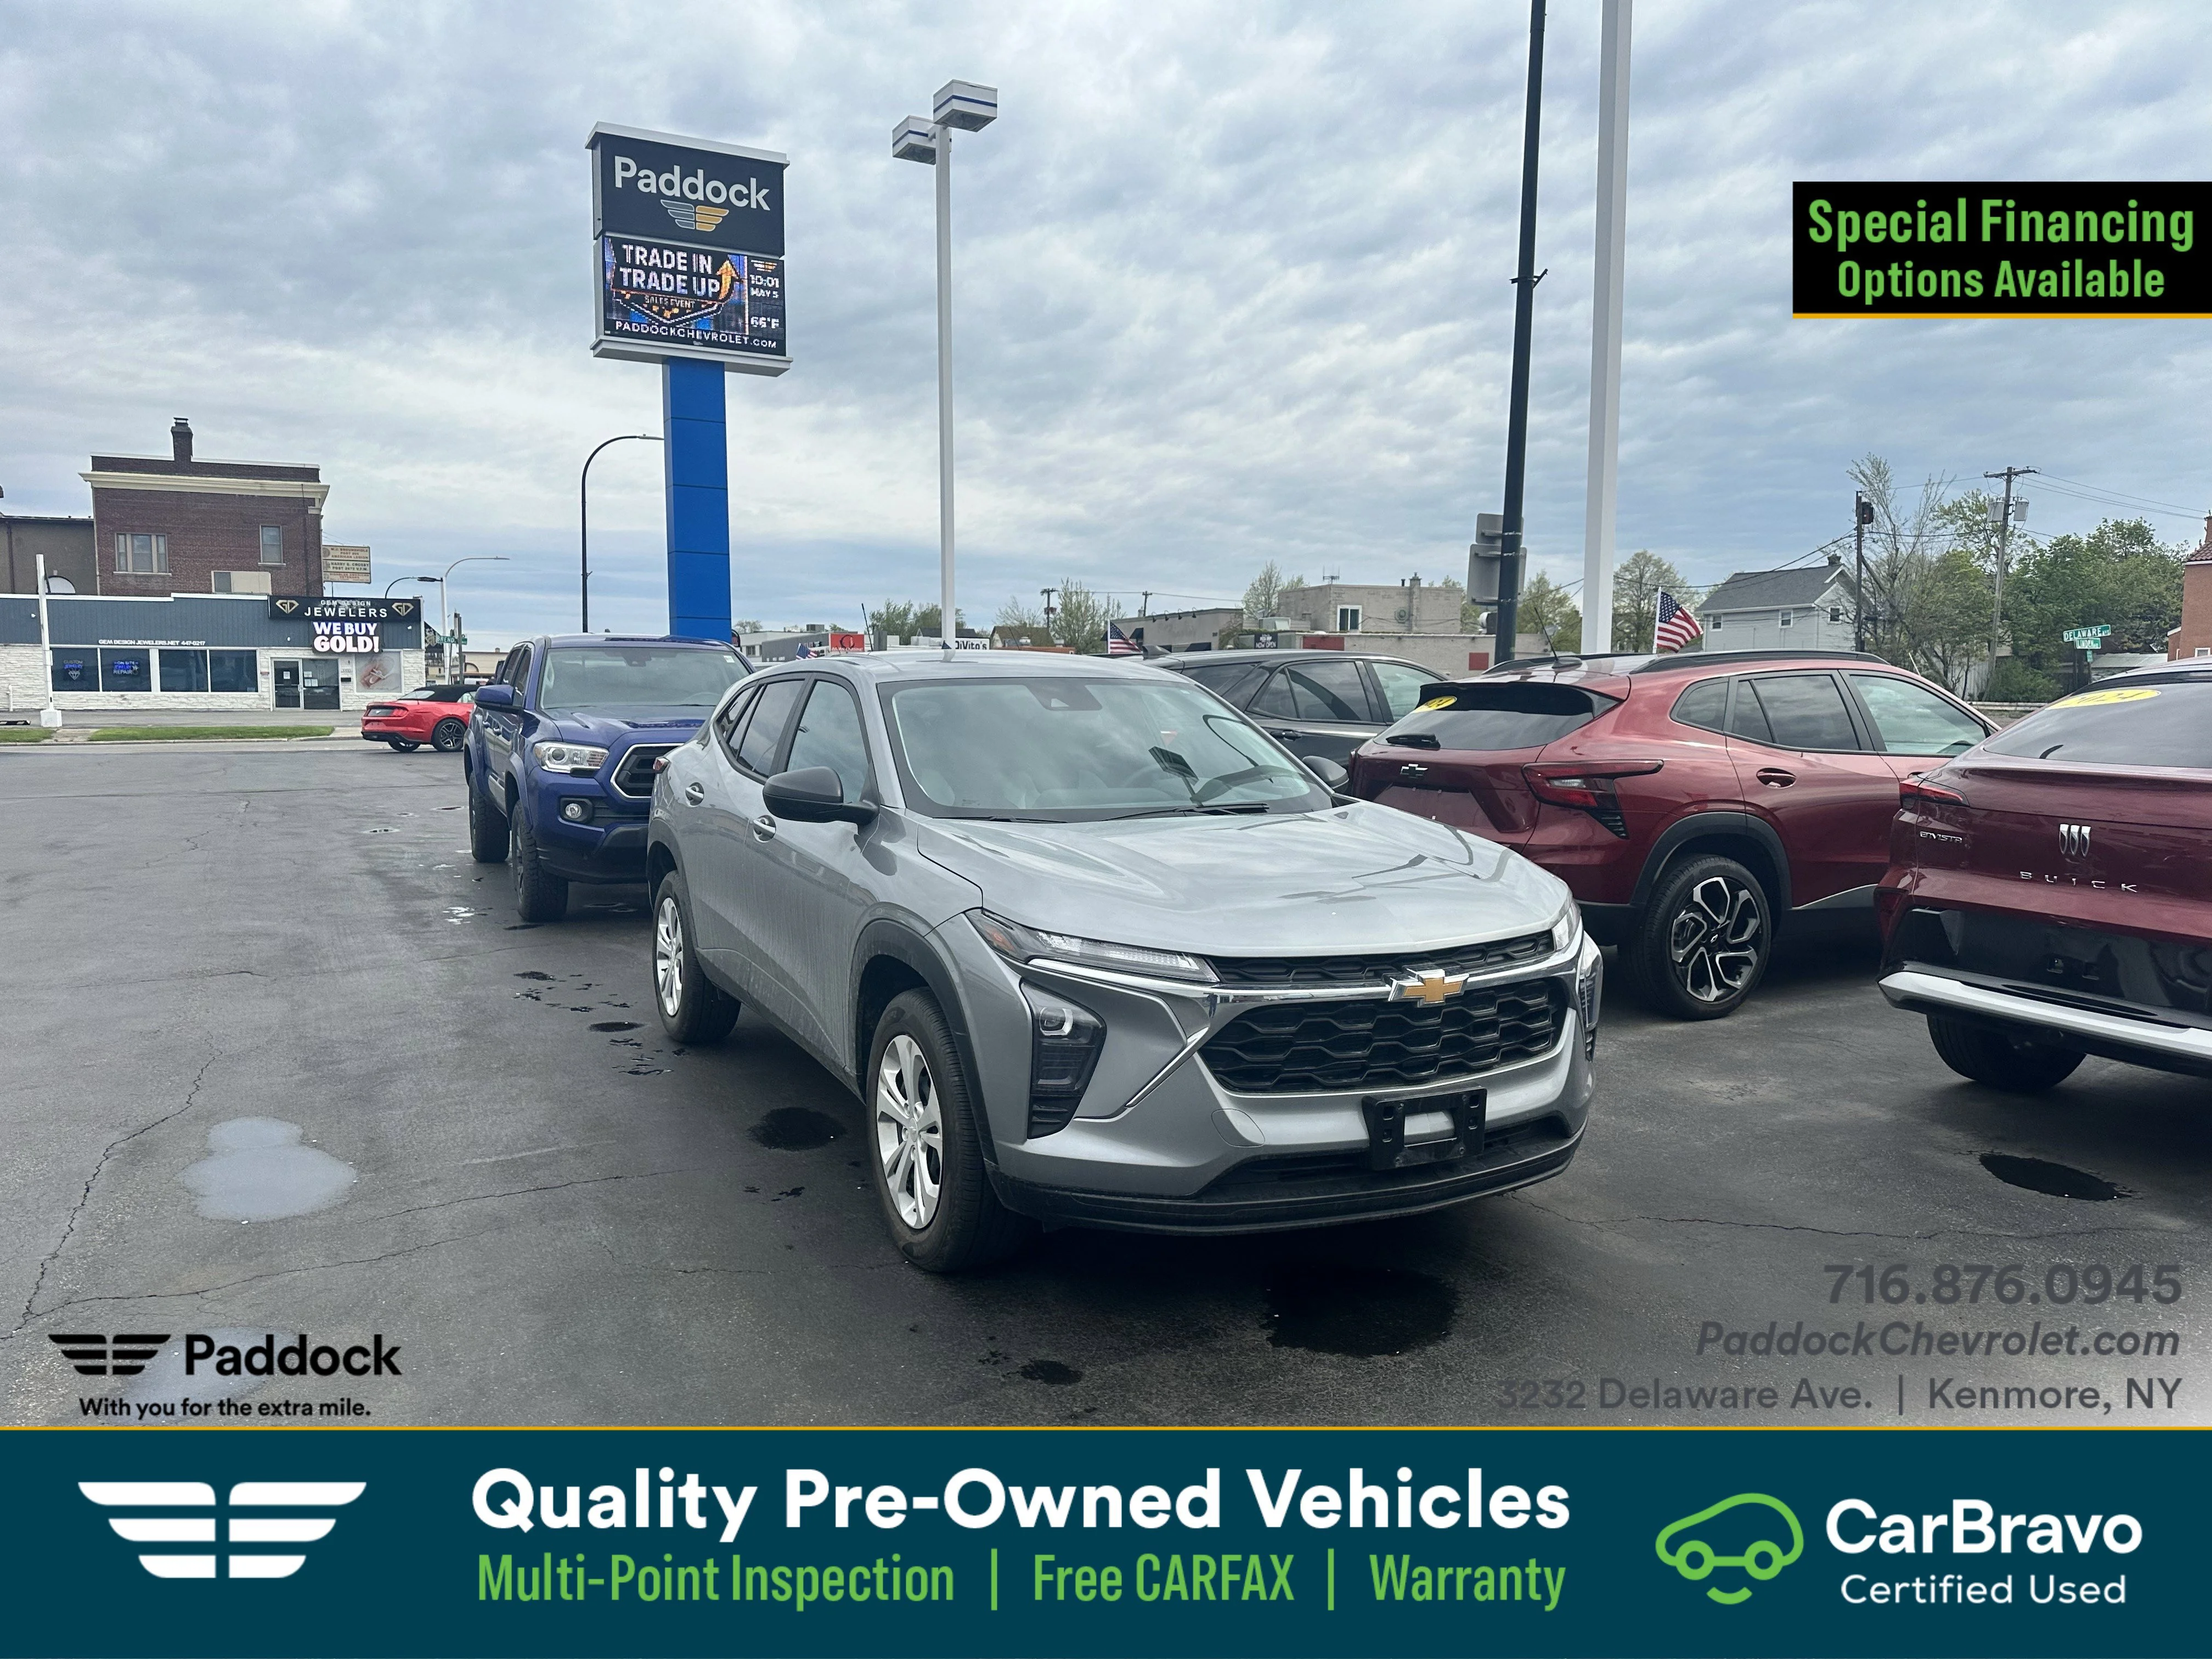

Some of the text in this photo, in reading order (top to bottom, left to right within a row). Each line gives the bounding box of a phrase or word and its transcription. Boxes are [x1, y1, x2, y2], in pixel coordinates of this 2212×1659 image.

[614, 156, 770, 211] Paddock
[622, 244, 713, 274] TRADE IN
[619, 267, 720, 297] TRADE UP
[750, 274, 779, 288] 10:01
[750, 287, 771, 297] MAY
[645, 295, 695, 308] SALES EVENT
[616, 320, 776, 348] PADDOCKCHEVROLET.COM
[304, 607, 387, 618] JEWELERS
[313, 622, 377, 635] WE BUY
[2064, 628, 2101, 641] DELAWARE
[313, 635, 379, 653] GOLD!
[2078, 639, 2094, 647] LINDEN
[2019, 871, 2138, 893] BUICK
